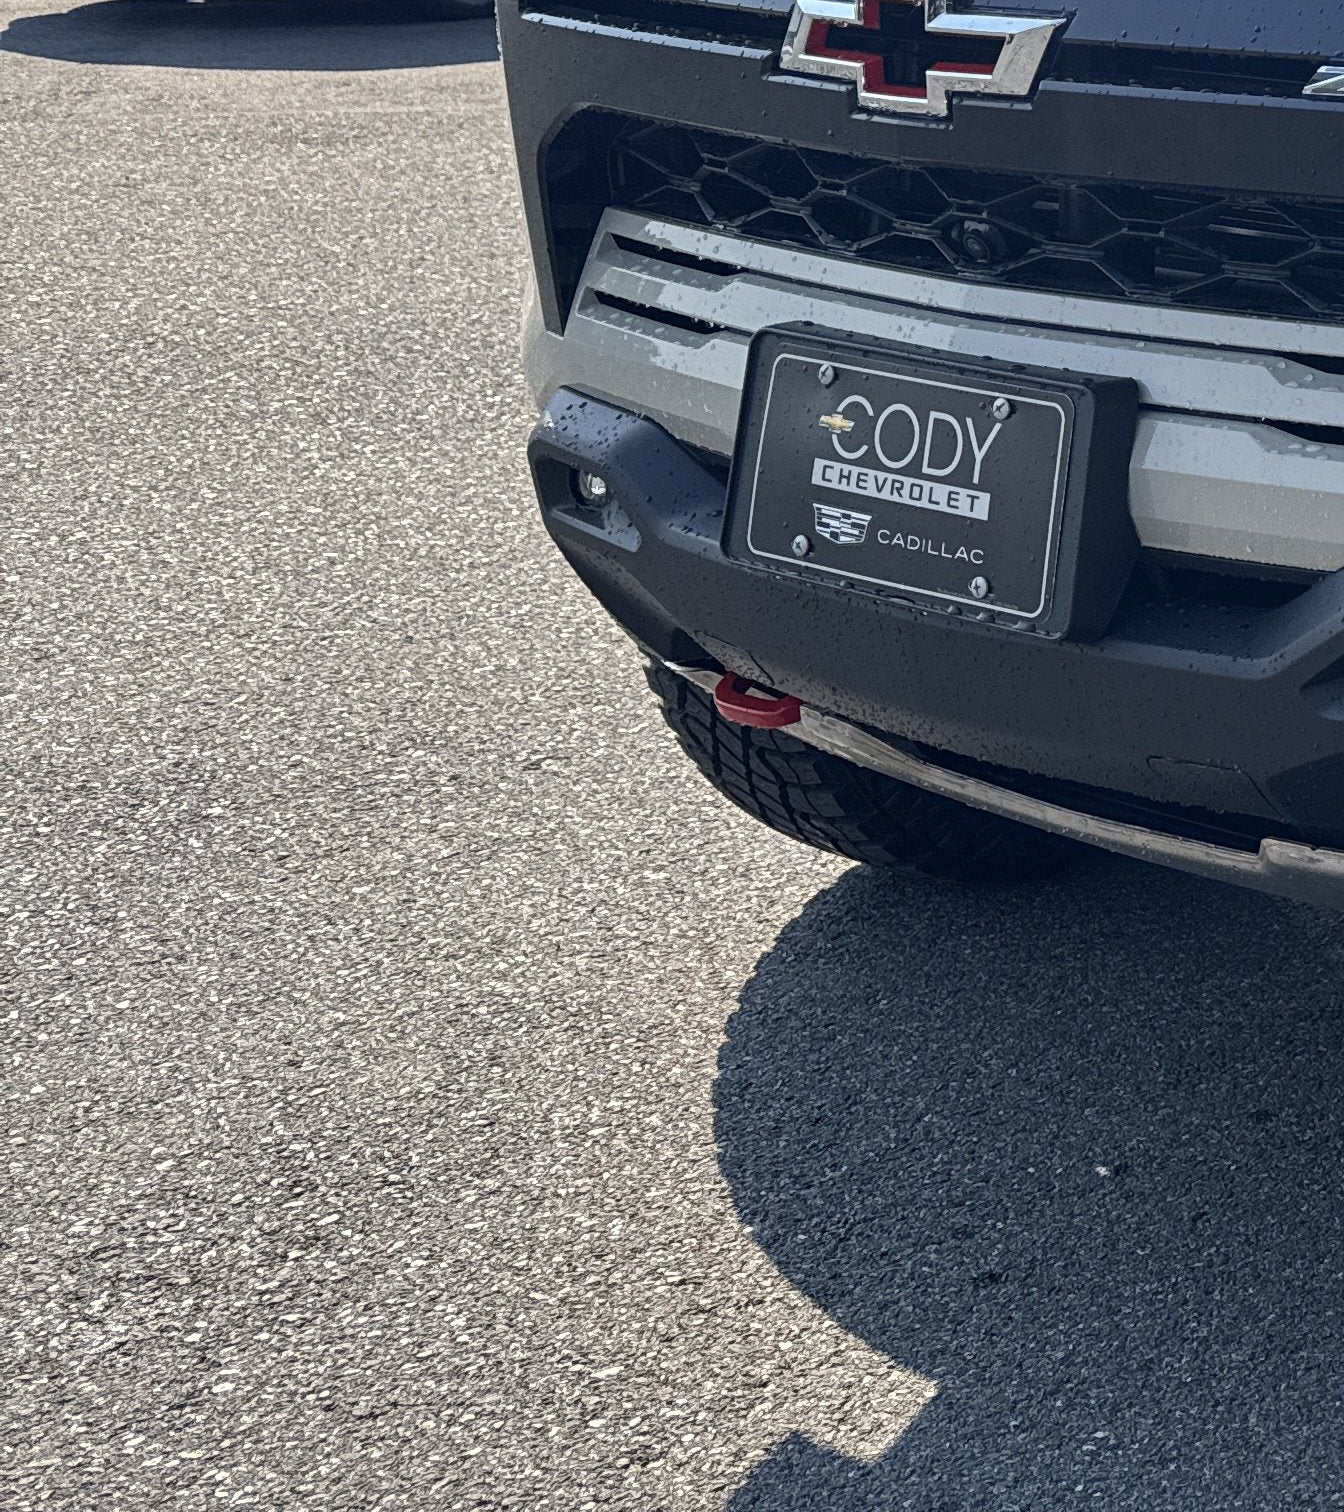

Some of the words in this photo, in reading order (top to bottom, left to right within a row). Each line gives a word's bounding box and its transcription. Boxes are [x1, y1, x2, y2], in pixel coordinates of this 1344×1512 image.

[831, 394, 1003, 485] CODY
[821, 463, 981, 514] CHEVROLET
[876, 528, 985, 566] CADILLAC
